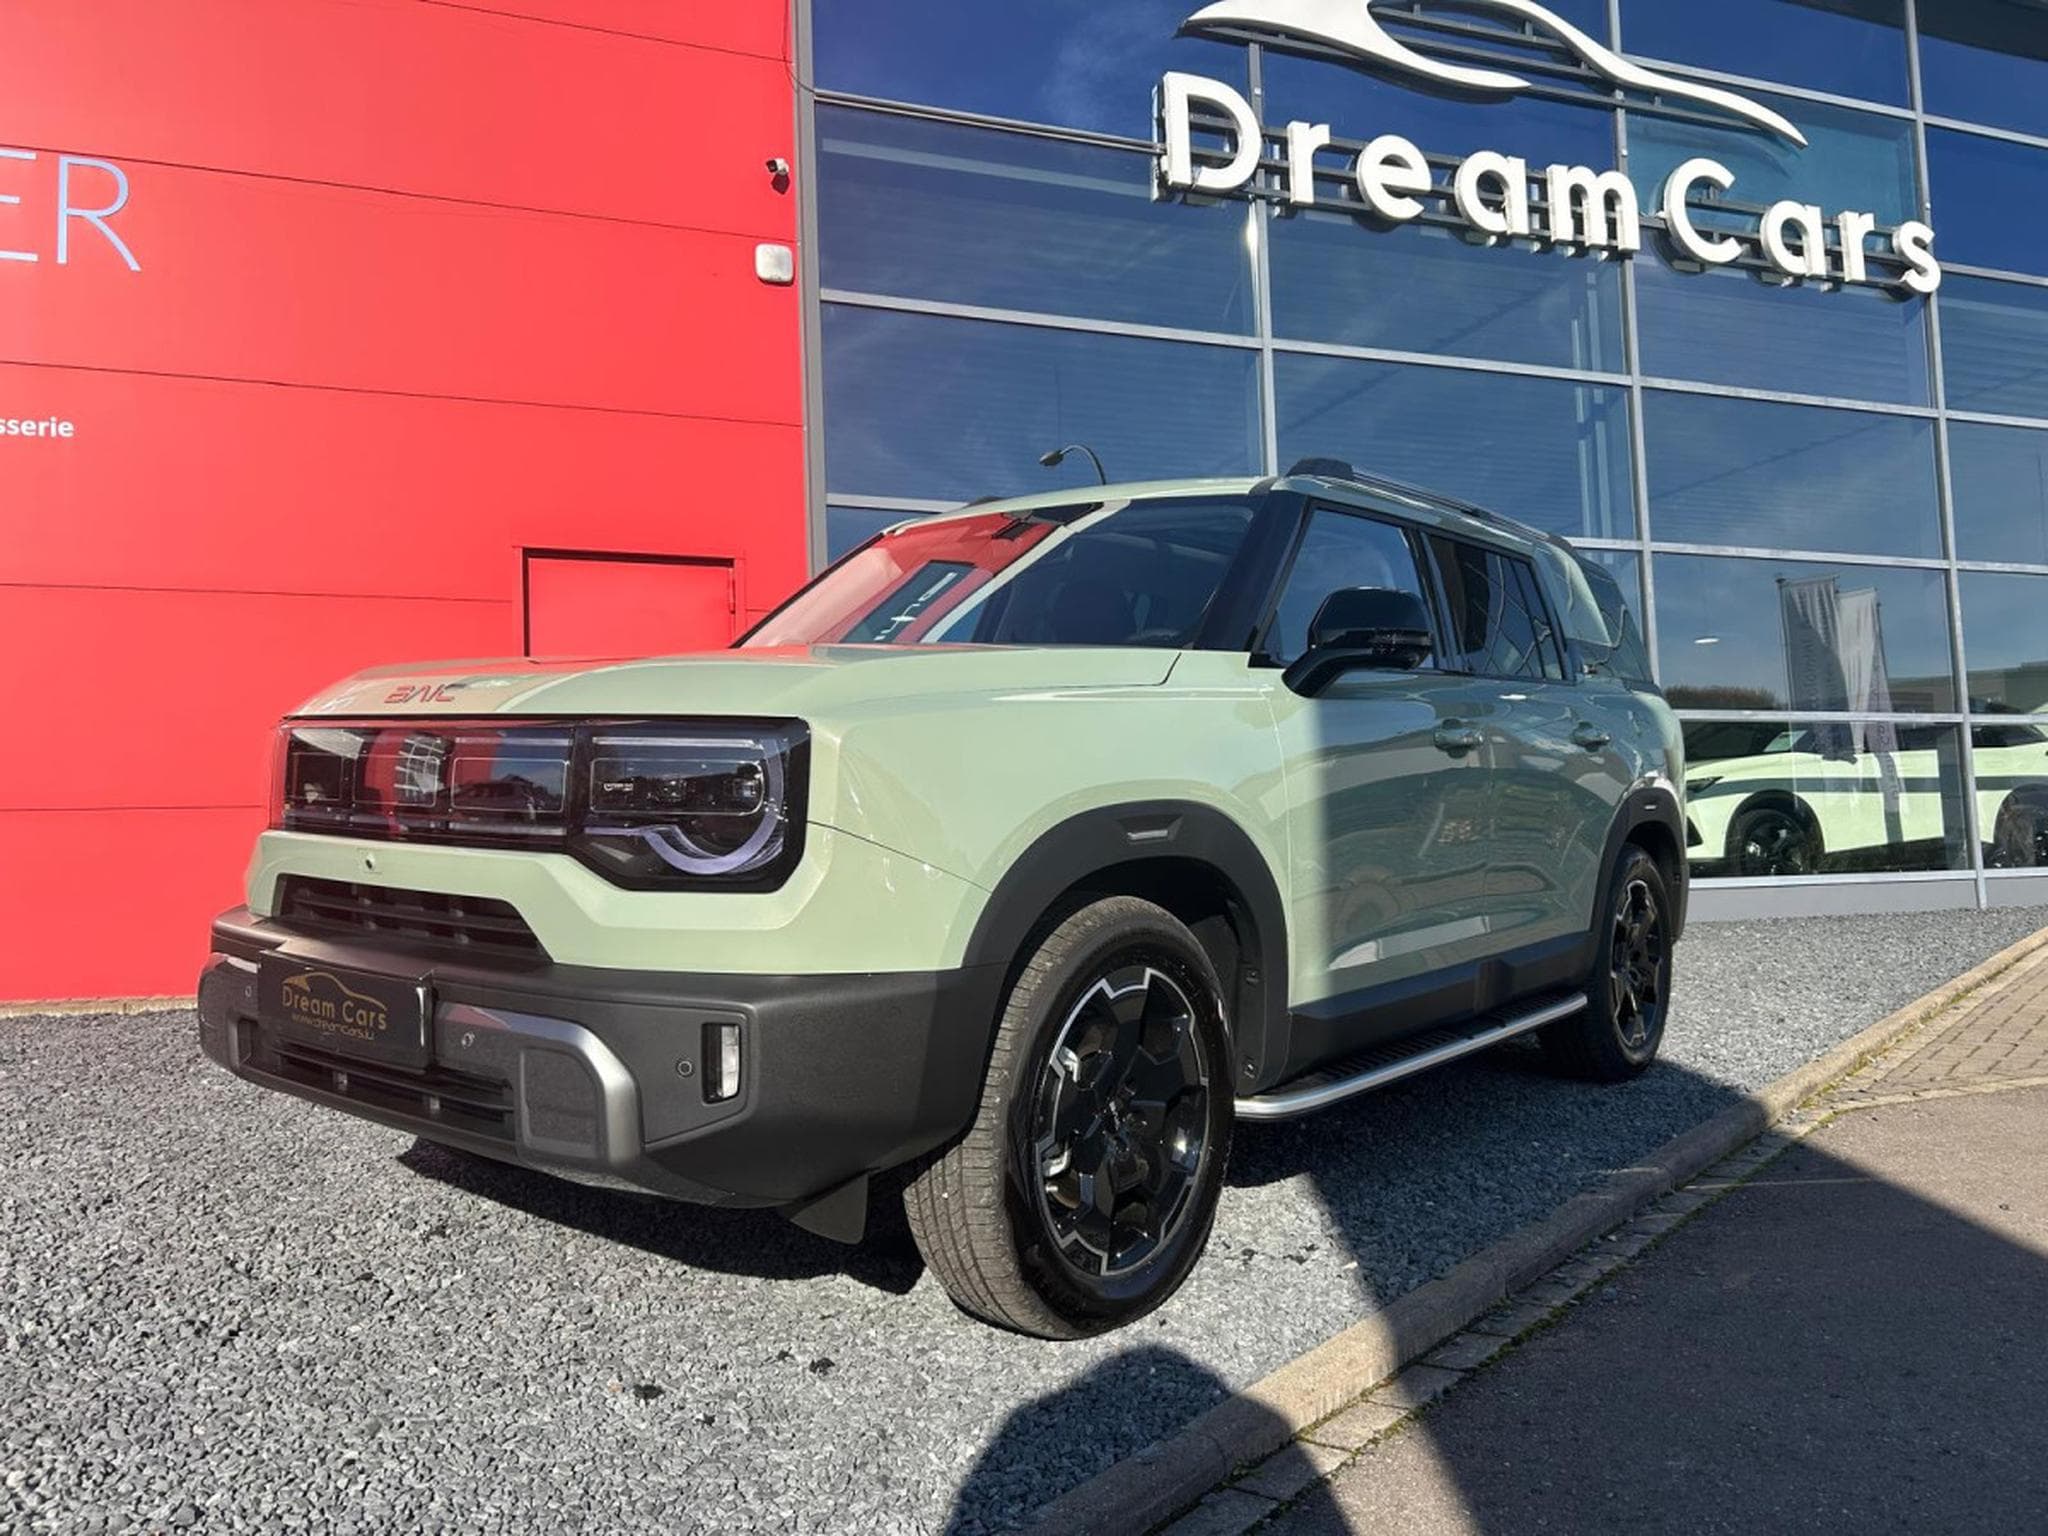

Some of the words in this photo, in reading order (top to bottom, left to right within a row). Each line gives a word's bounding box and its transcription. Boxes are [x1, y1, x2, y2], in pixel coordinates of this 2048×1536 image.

[1158, 70, 1640, 254] Dream
[1660, 157, 1942, 296] Cars
[281, 985, 336, 1019] Dream
[341, 1000, 388, 1031] Cars
